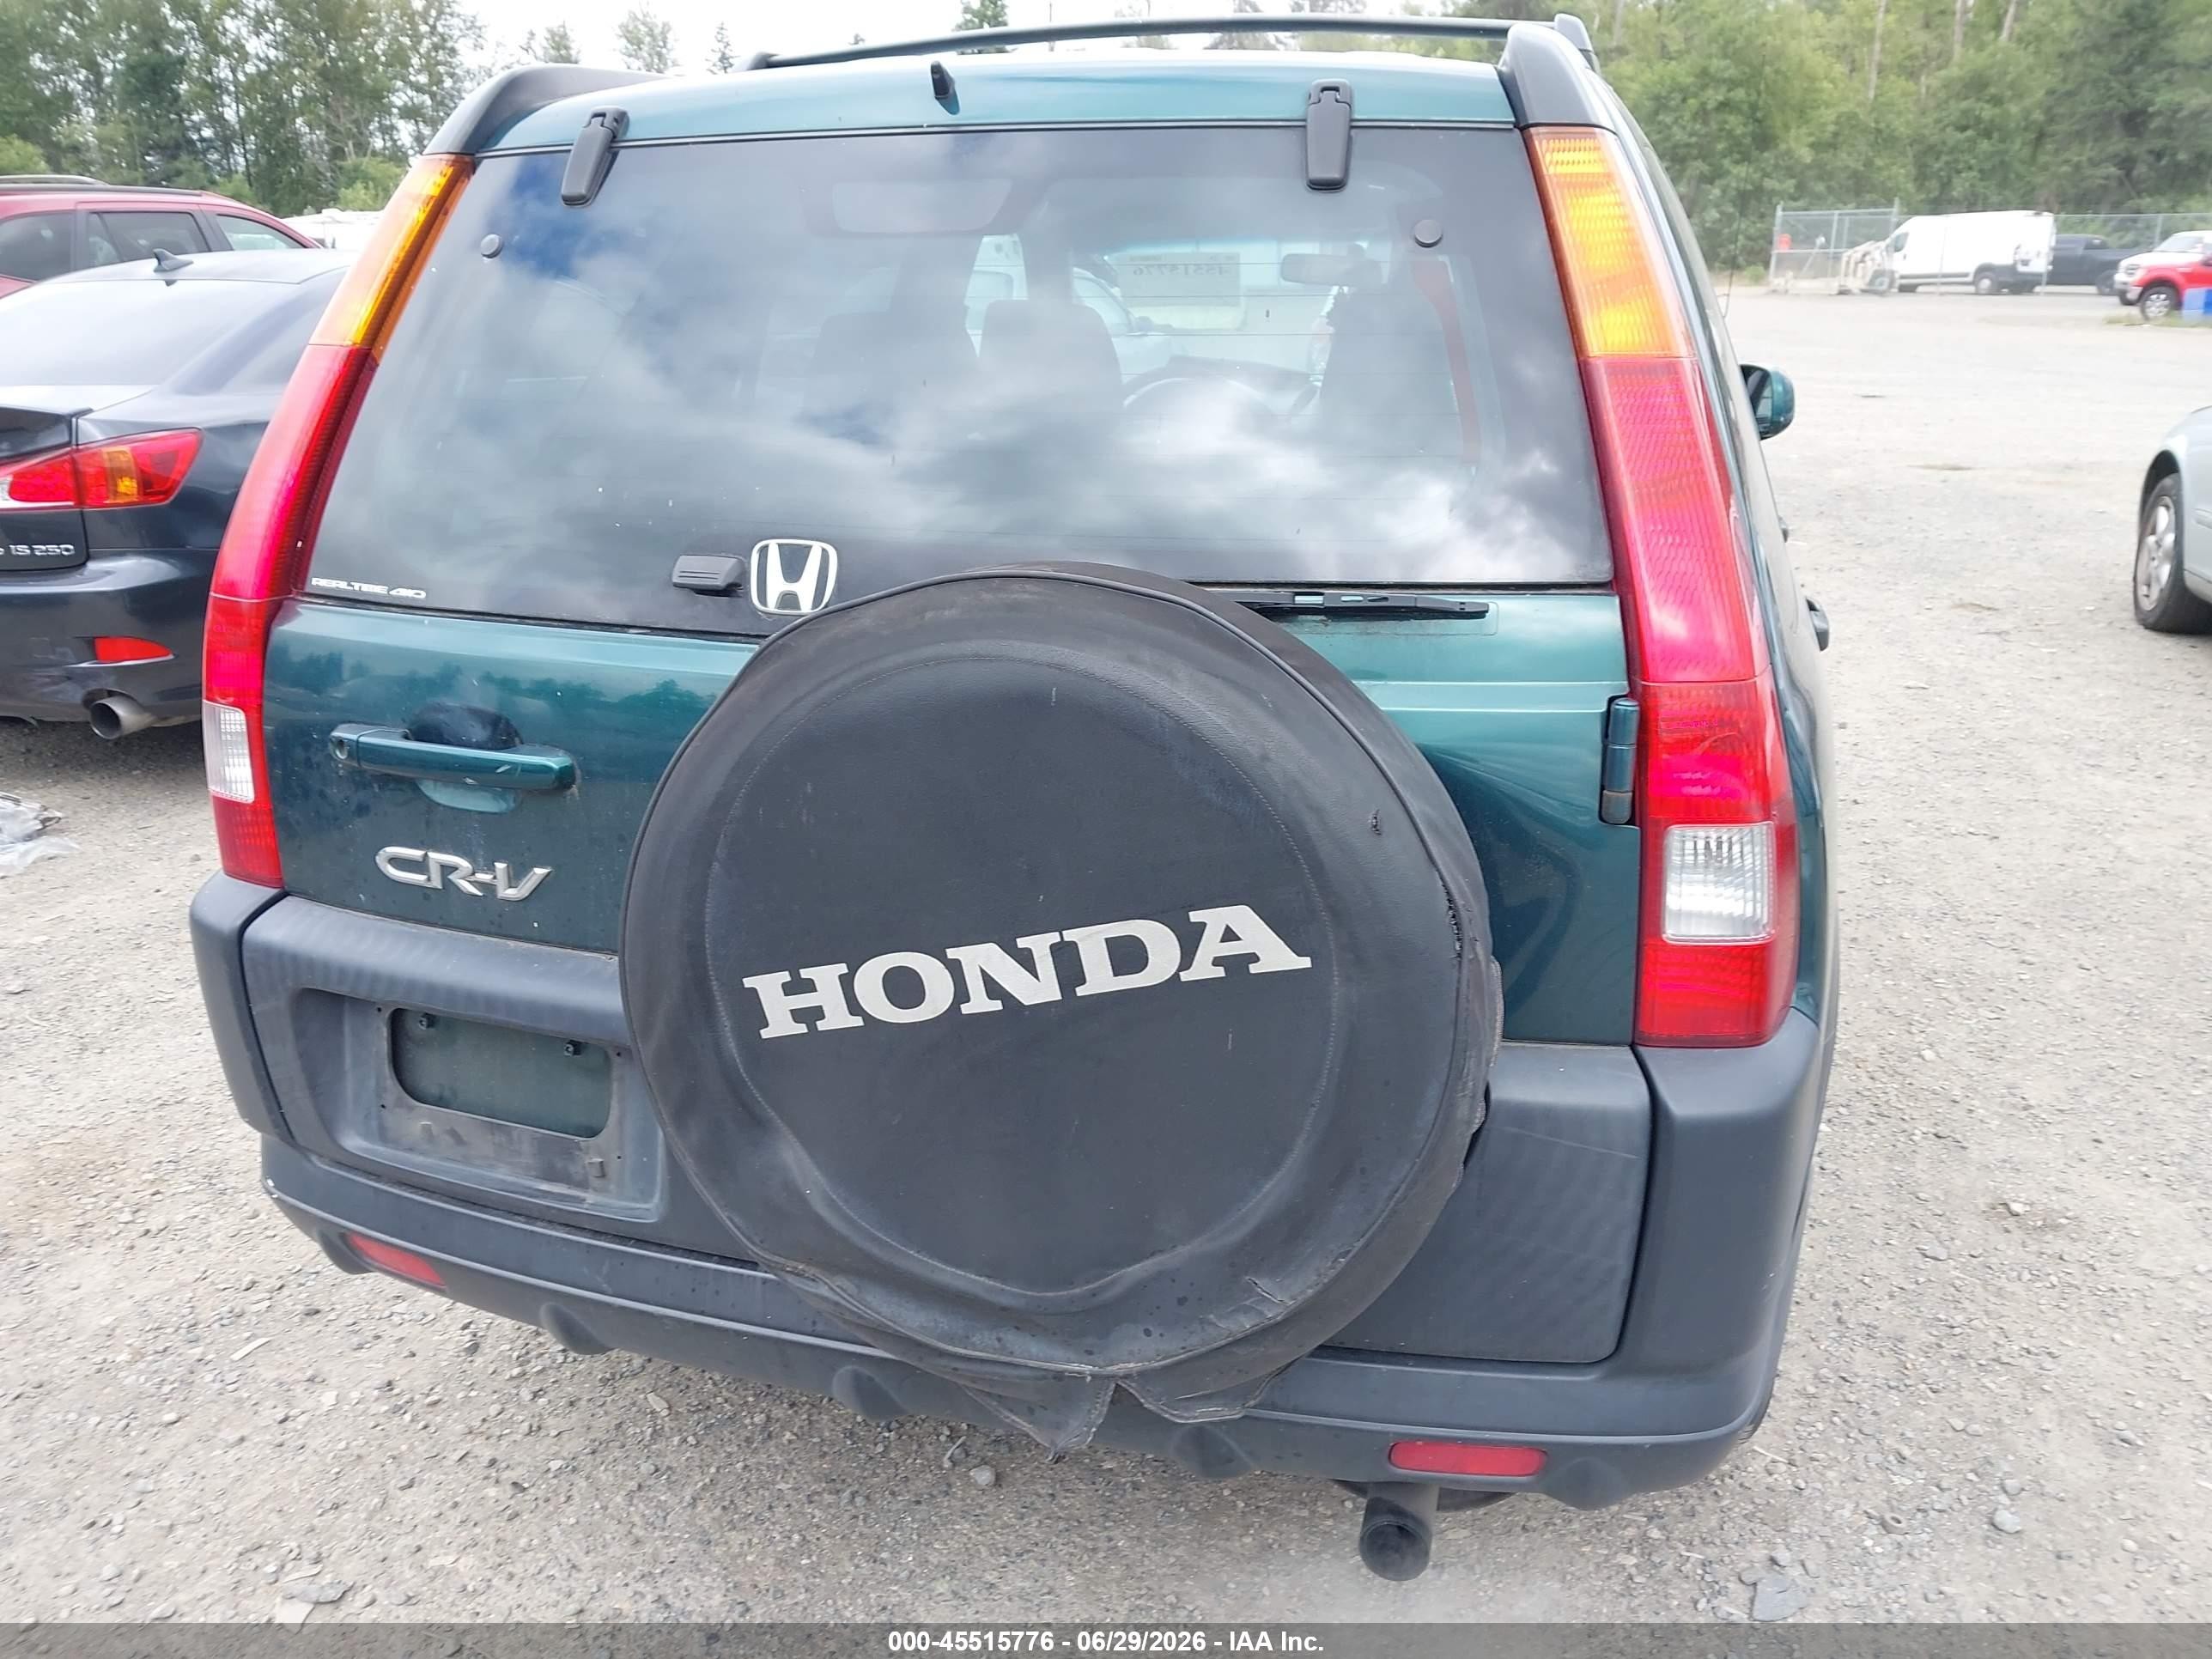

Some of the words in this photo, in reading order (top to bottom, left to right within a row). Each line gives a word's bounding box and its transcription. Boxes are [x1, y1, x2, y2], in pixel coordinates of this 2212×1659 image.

[9, 544, 31, 556] IS
[32, 544, 76, 556] 250
[375, 846, 553, 902] CR-V
[743, 904, 1312, 1039] HONDA
